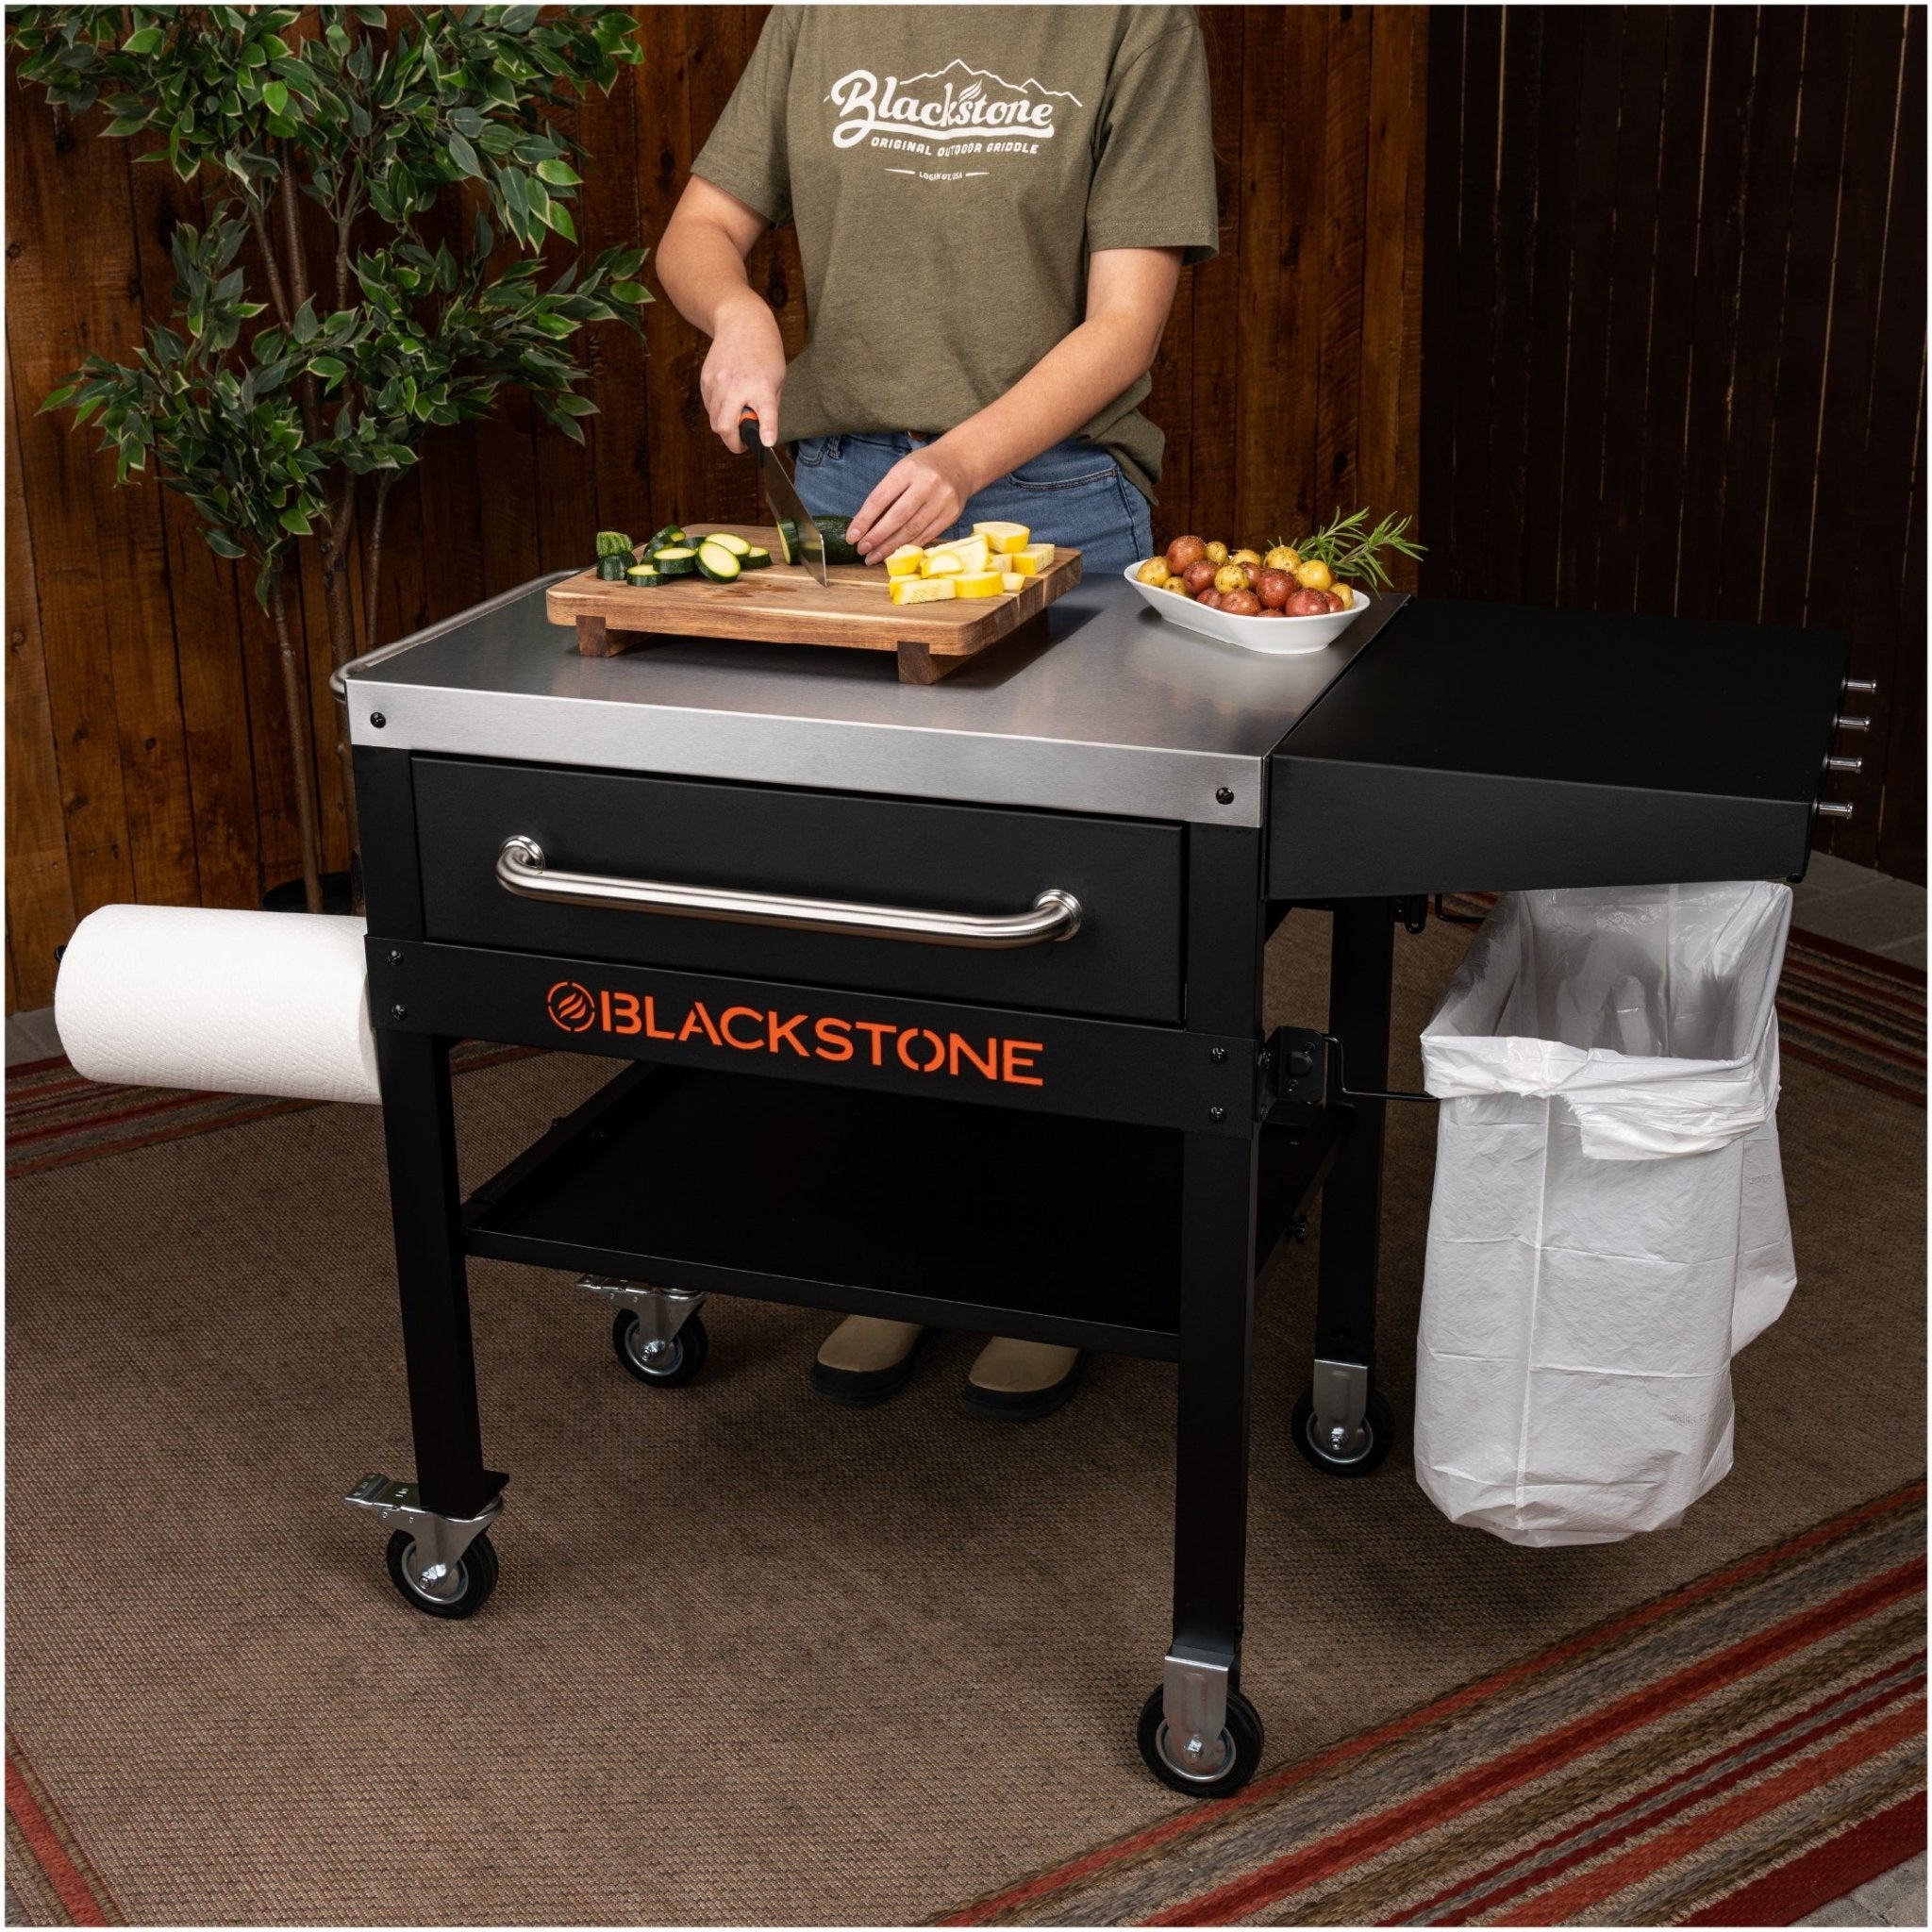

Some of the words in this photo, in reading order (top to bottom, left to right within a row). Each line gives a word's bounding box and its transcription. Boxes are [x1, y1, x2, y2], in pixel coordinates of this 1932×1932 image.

[830, 69, 1055, 148] Blackstone
[871, 137, 931, 156] ORIGINAL
[937, 142, 981, 157] OUTDOOR
[988, 142, 1039, 154] GRIDDLE
[602, 991, 1043, 1086] BLACKSTONE
